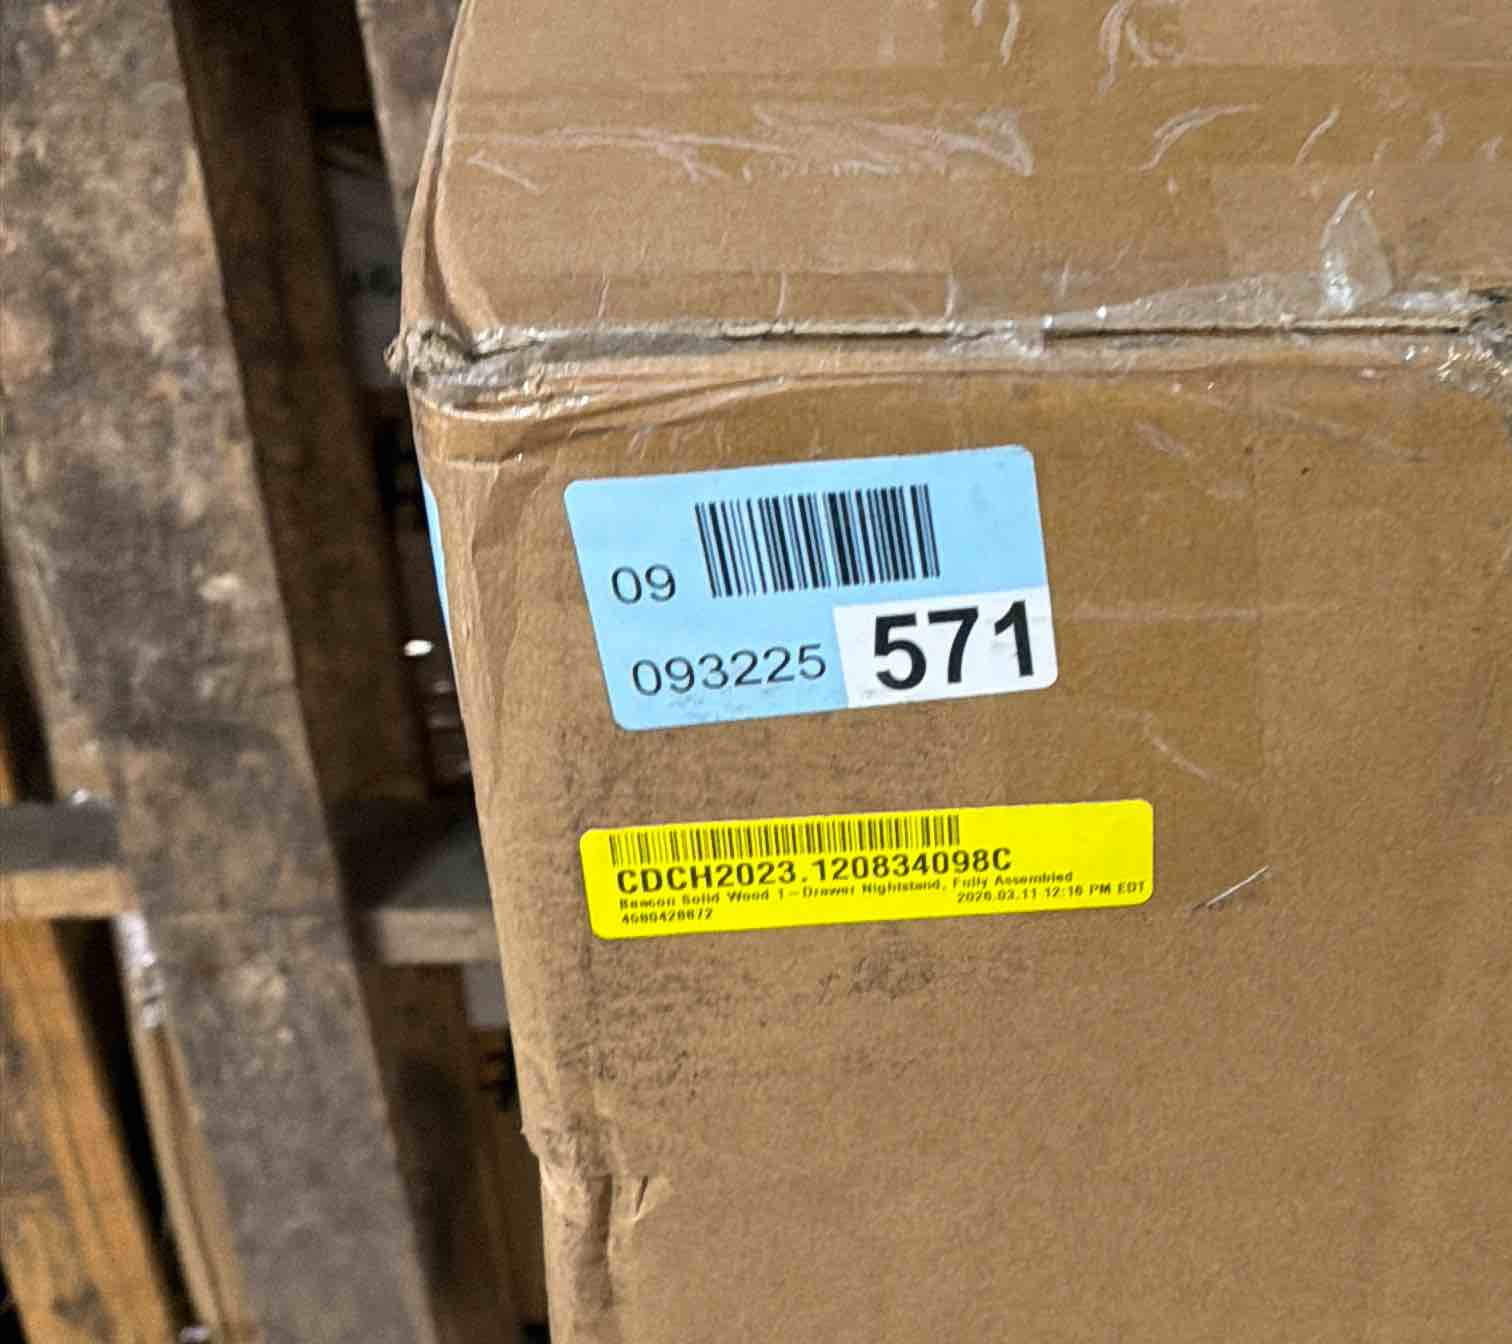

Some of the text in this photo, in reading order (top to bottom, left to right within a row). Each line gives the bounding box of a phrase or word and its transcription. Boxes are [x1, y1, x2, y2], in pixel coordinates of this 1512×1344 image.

[610, 563, 676, 605] 09
[631, 599, 1035, 697] 093225 571
[617, 847, 1011, 894] CDCH2023.120834098C
[682, 891, 720, 906] Solid
[727, 887, 769, 902] Wood
[953, 876, 988, 889] Fully
[995, 871, 1074, 887] Assembled
[1089, 882, 1112, 896] PM
[1117, 880, 1146, 894] EDT
